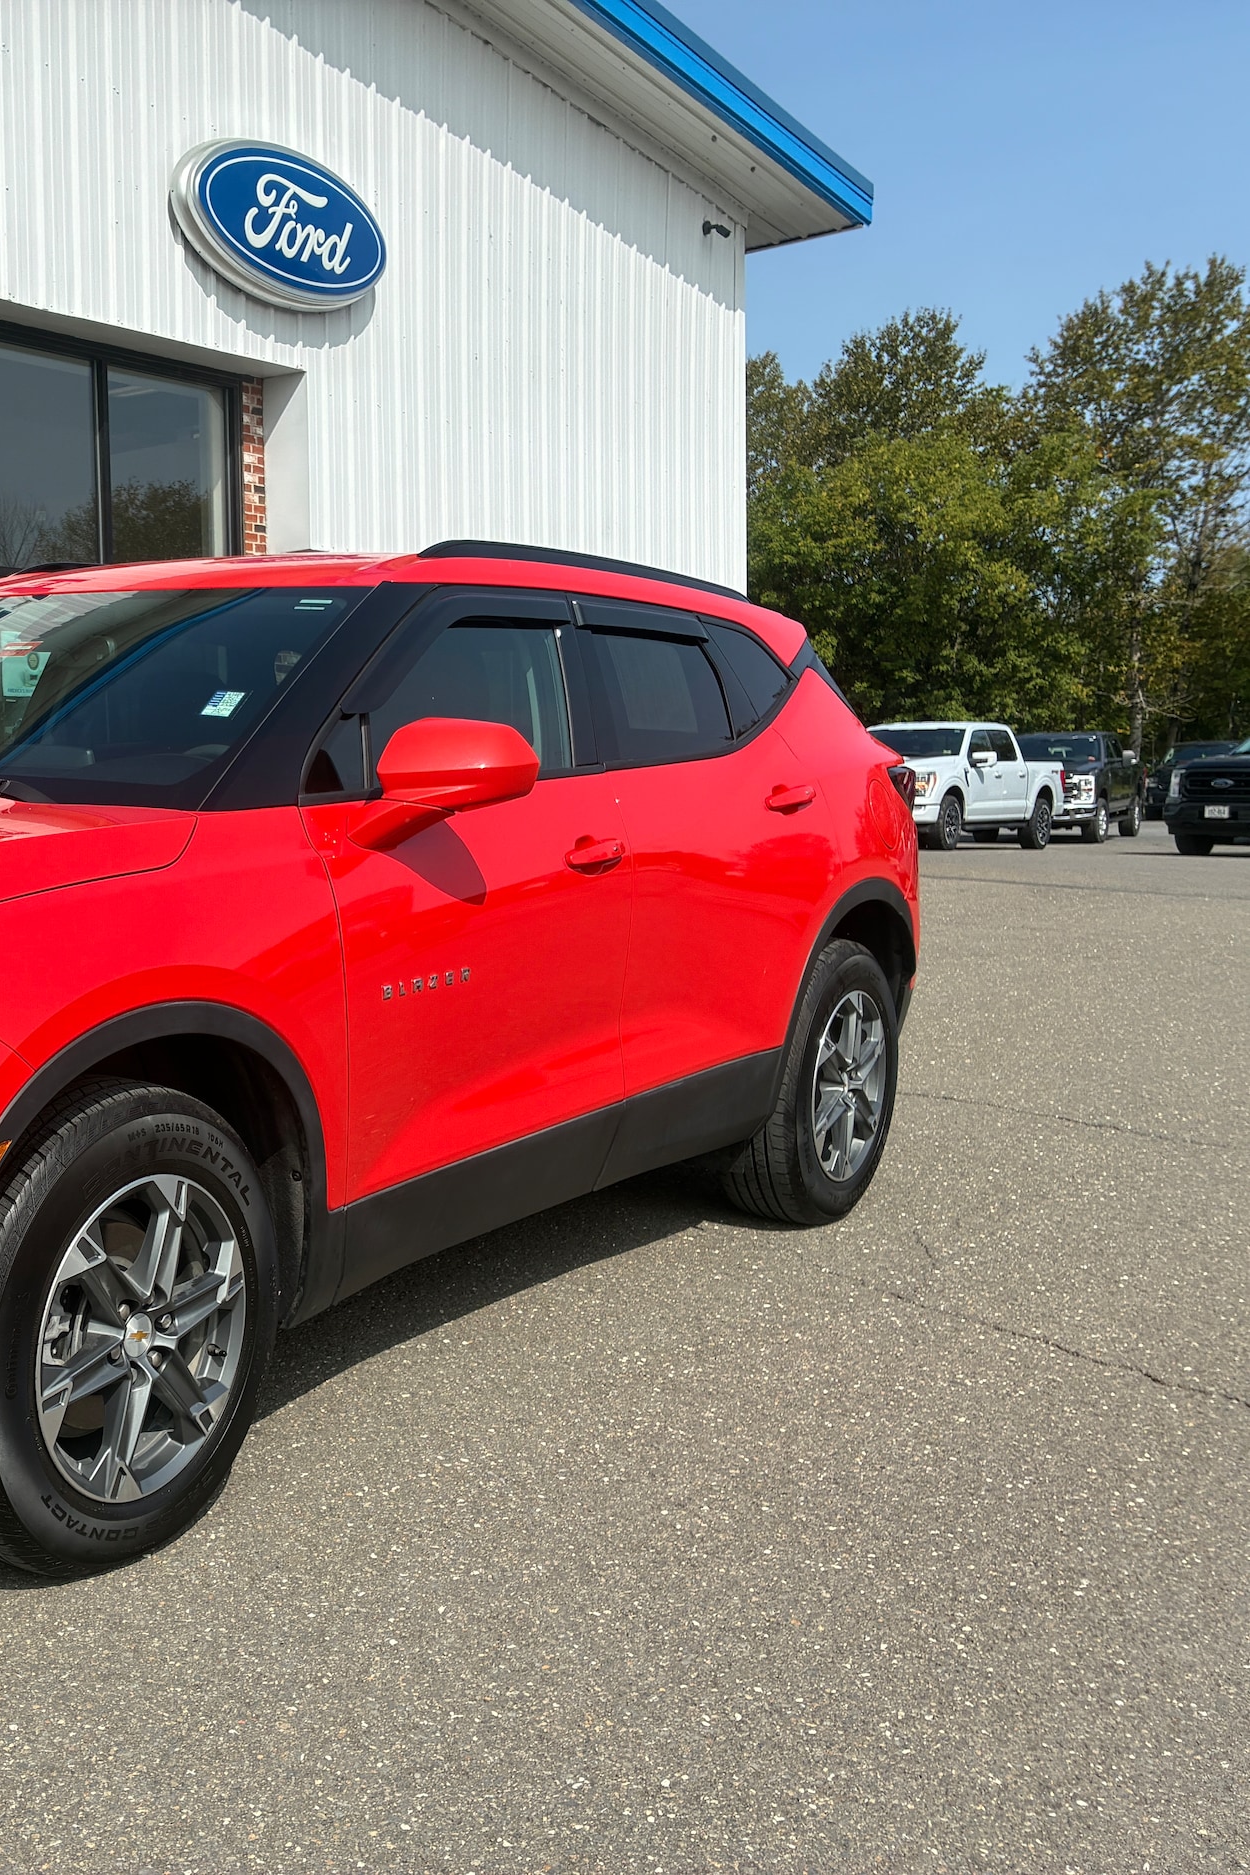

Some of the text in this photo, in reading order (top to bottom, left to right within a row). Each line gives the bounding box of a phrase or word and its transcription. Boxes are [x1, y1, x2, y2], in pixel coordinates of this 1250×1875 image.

[244, 173, 353, 275] Ford
[381, 967, 470, 1000] BLAZER
[40, 1494, 138, 1542] CONTACT
